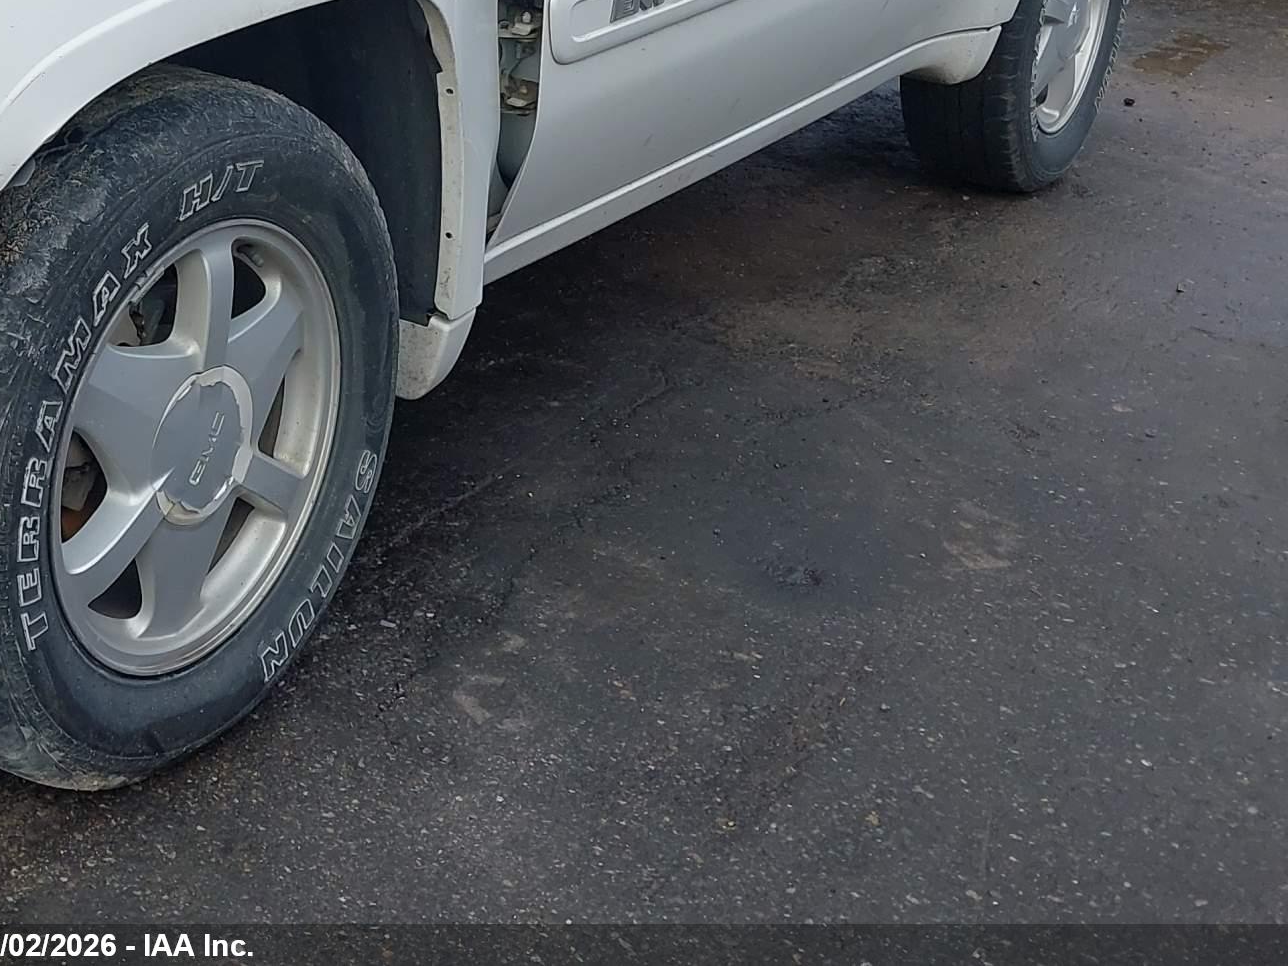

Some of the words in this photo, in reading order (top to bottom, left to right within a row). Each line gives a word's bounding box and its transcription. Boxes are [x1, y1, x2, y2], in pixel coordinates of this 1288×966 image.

[178, 159, 265, 222] H/T
[189, 411, 226, 486] GMC
[261, 449, 378, 683] SAILUN
